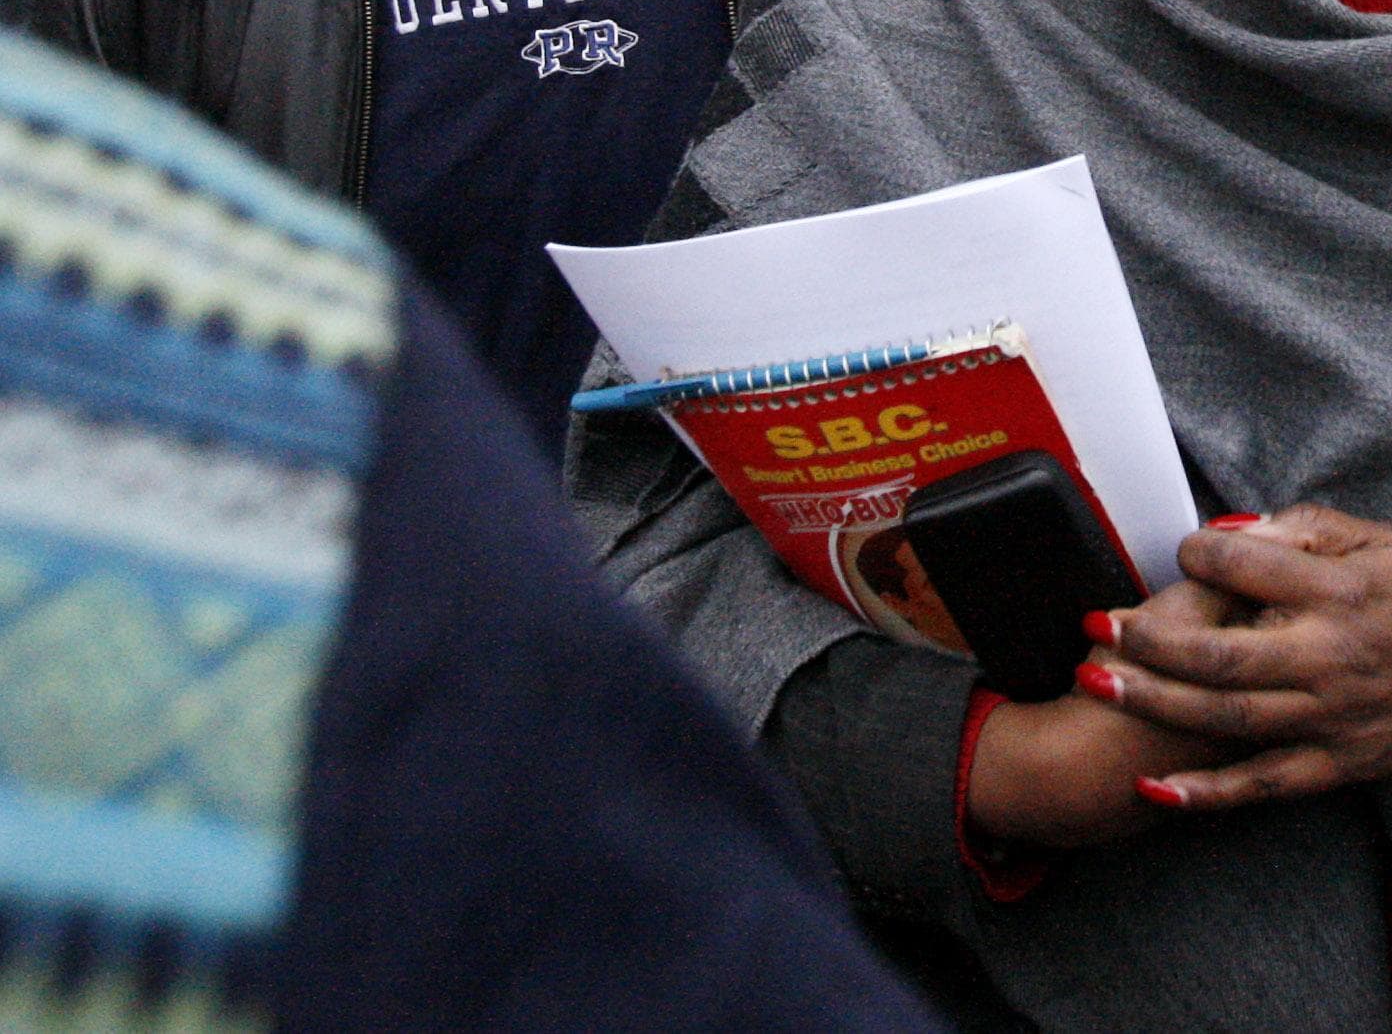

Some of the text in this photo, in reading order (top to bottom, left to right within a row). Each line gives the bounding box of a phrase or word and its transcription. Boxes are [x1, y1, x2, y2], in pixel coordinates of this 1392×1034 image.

[538, 19, 624, 78] PR
[766, 404, 948, 460] S.B.C.
[808, 453, 917, 484] Business
[919, 430, 1008, 464] Choice
